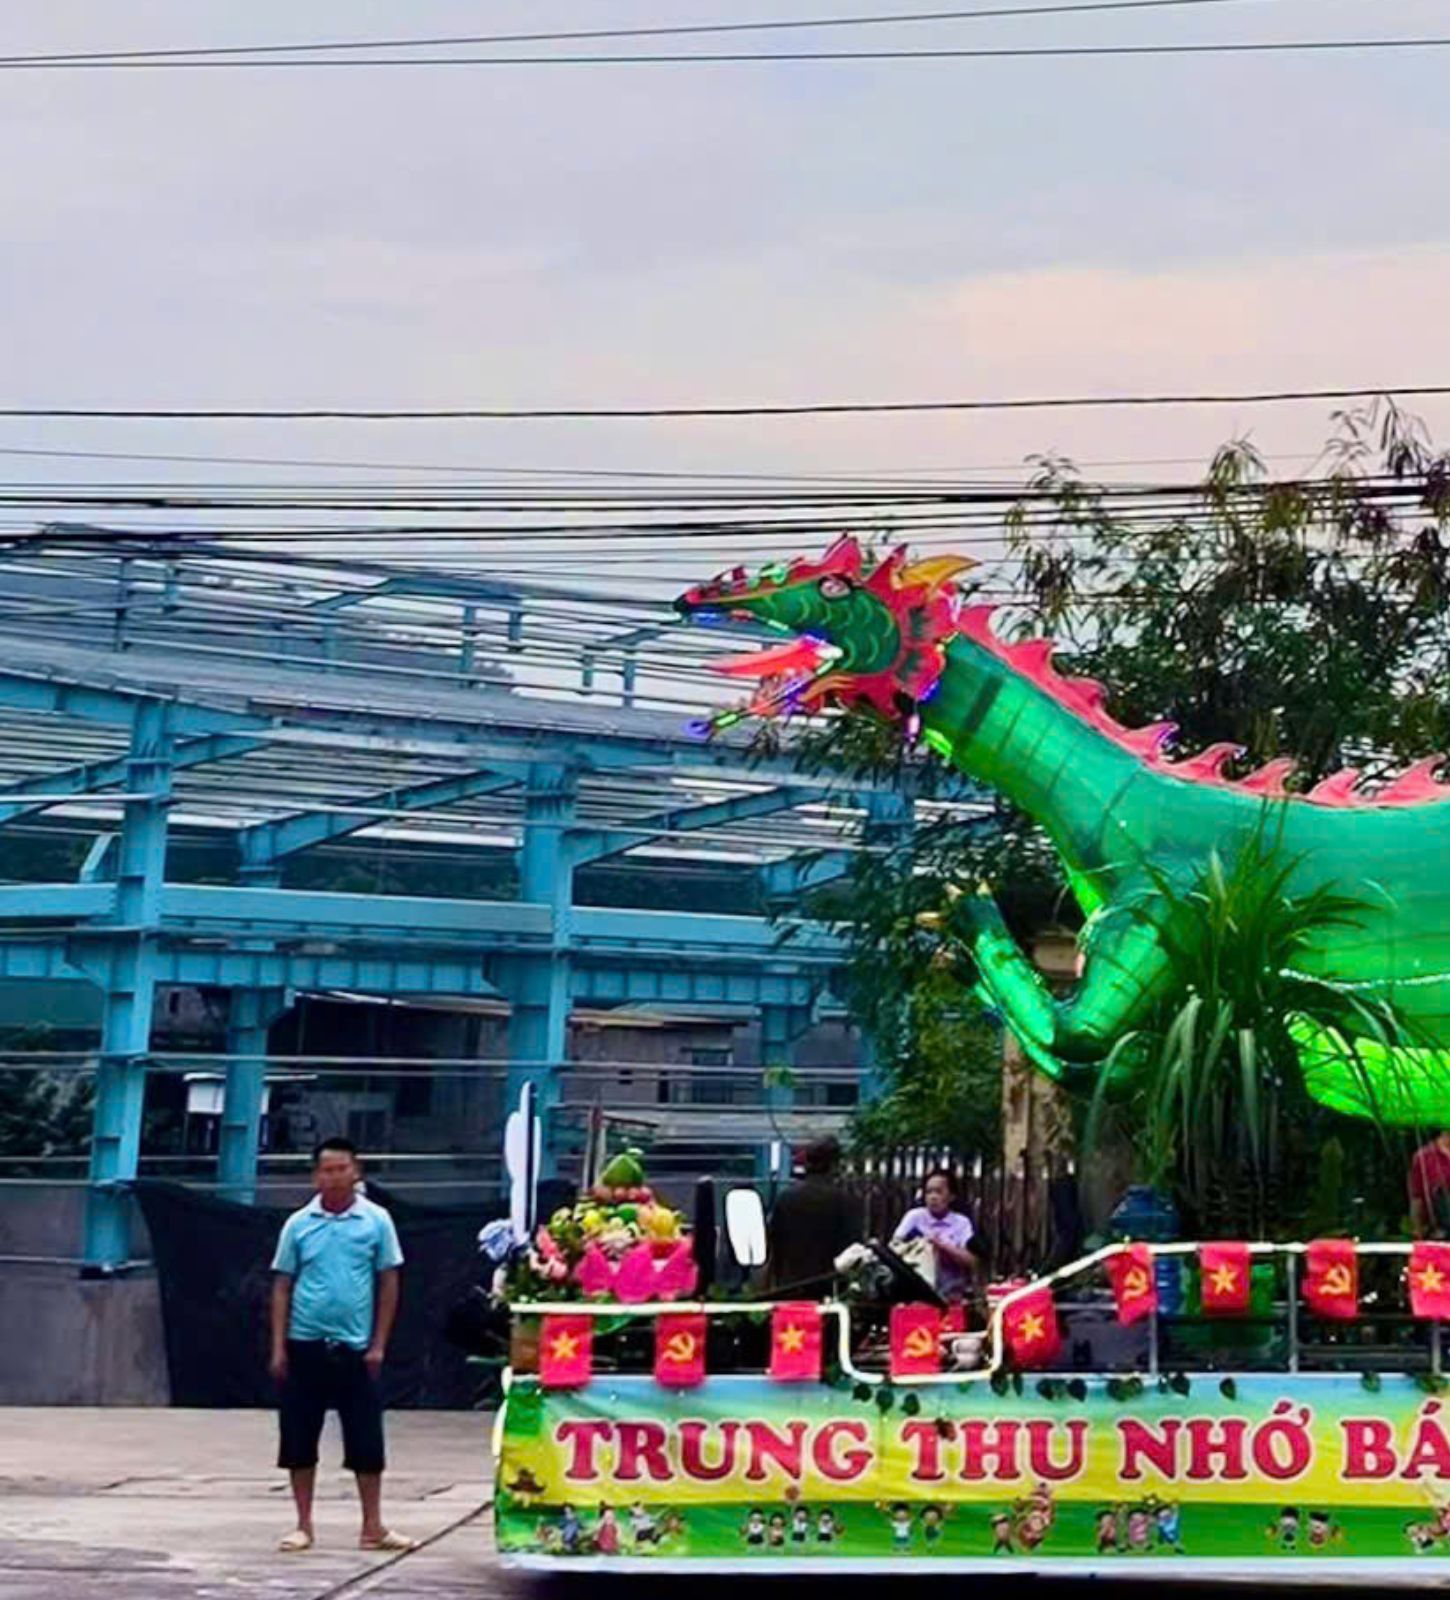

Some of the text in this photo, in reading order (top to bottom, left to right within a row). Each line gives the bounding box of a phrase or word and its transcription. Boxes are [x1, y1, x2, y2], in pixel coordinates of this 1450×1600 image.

[555, 1418, 874, 1482] TRUNG
[902, 1418, 1088, 1482] THU
[1118, 1400, 1312, 1481] NHỚ
